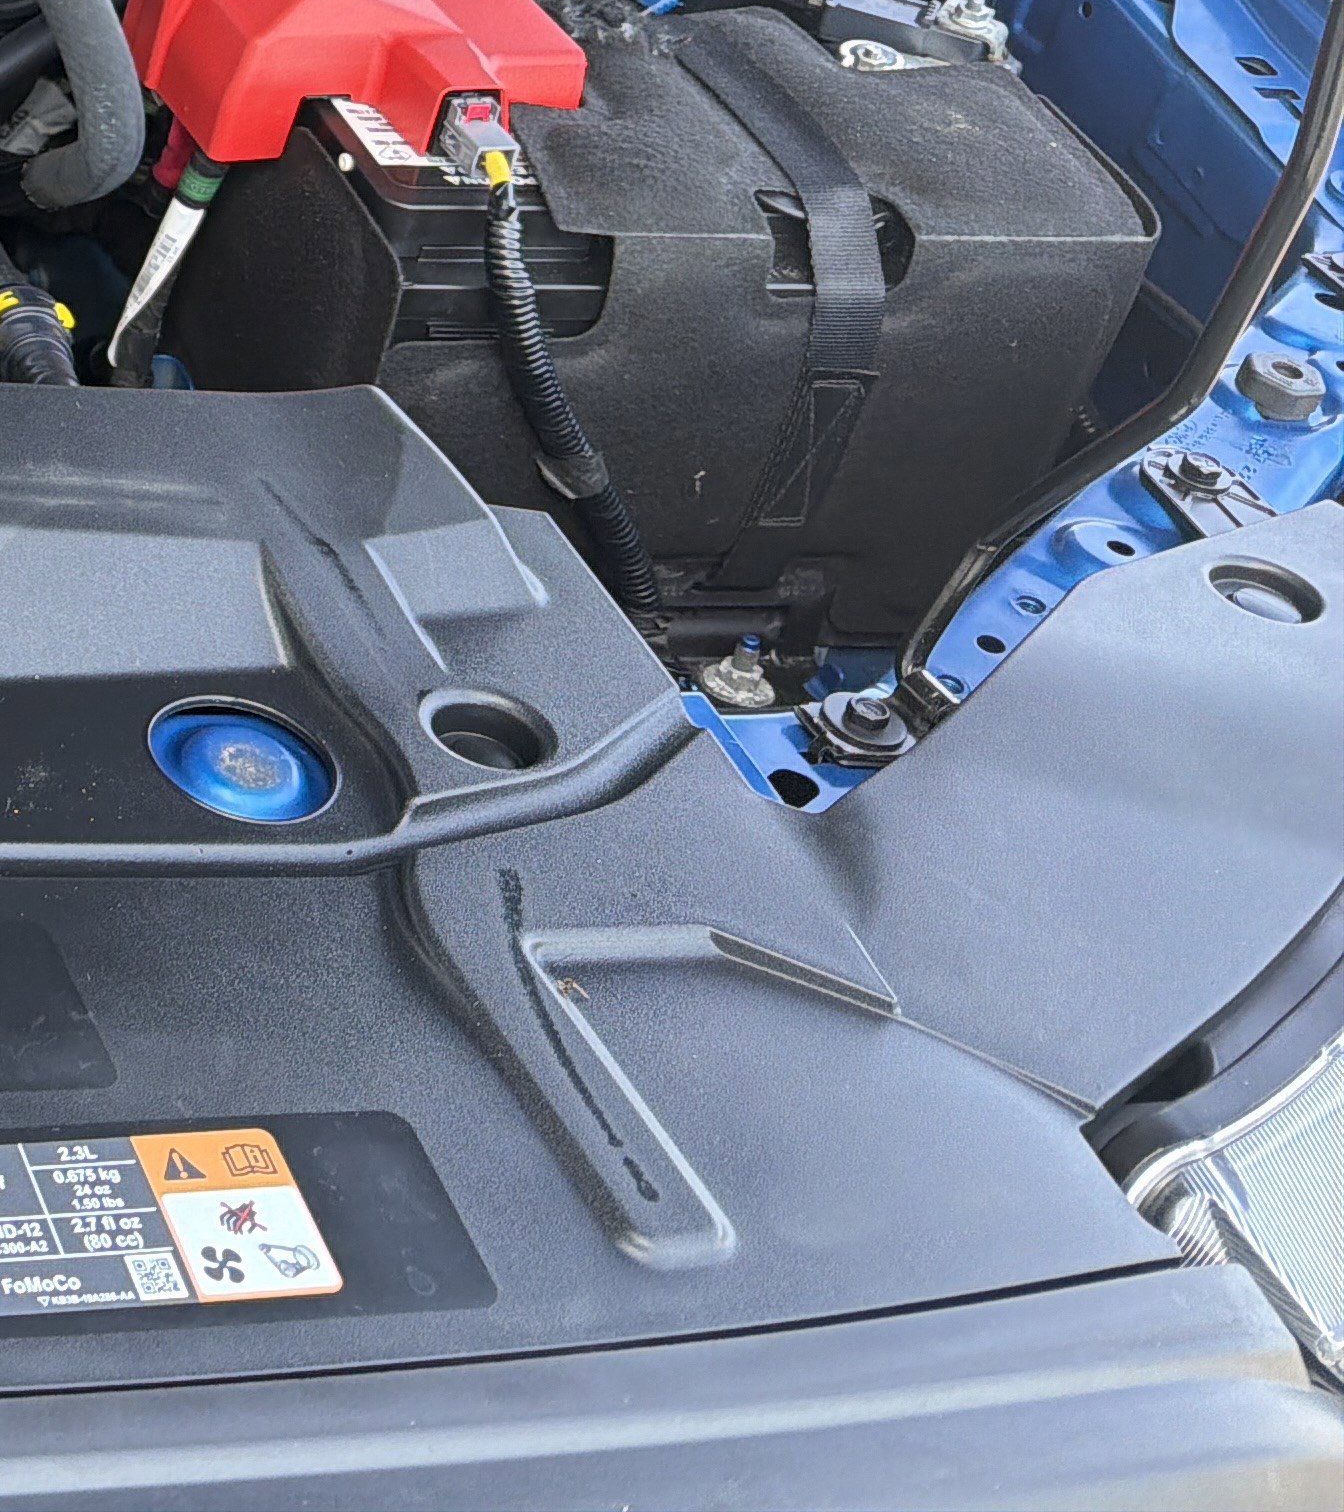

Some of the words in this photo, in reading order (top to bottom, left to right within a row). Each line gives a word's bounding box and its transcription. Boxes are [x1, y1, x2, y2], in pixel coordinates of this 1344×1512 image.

[56, 1145, 99, 1162] 2.3L
[98, 1167, 121, 1184] kg
[73, 1184, 93, 1197] 24
[93, 1184, 113, 1196] oz
[102, 1196, 125, 1209] lbs
[70, 1217, 98, 1234] 2.7
[100, 1215, 117, 1232] fl
[118, 1216, 143, 1230] oz
[83, 1232, 114, 1252] (80
[115, 1231, 144, 1250] cc)
[1, 1274, 82, 1295] FoMoCo
